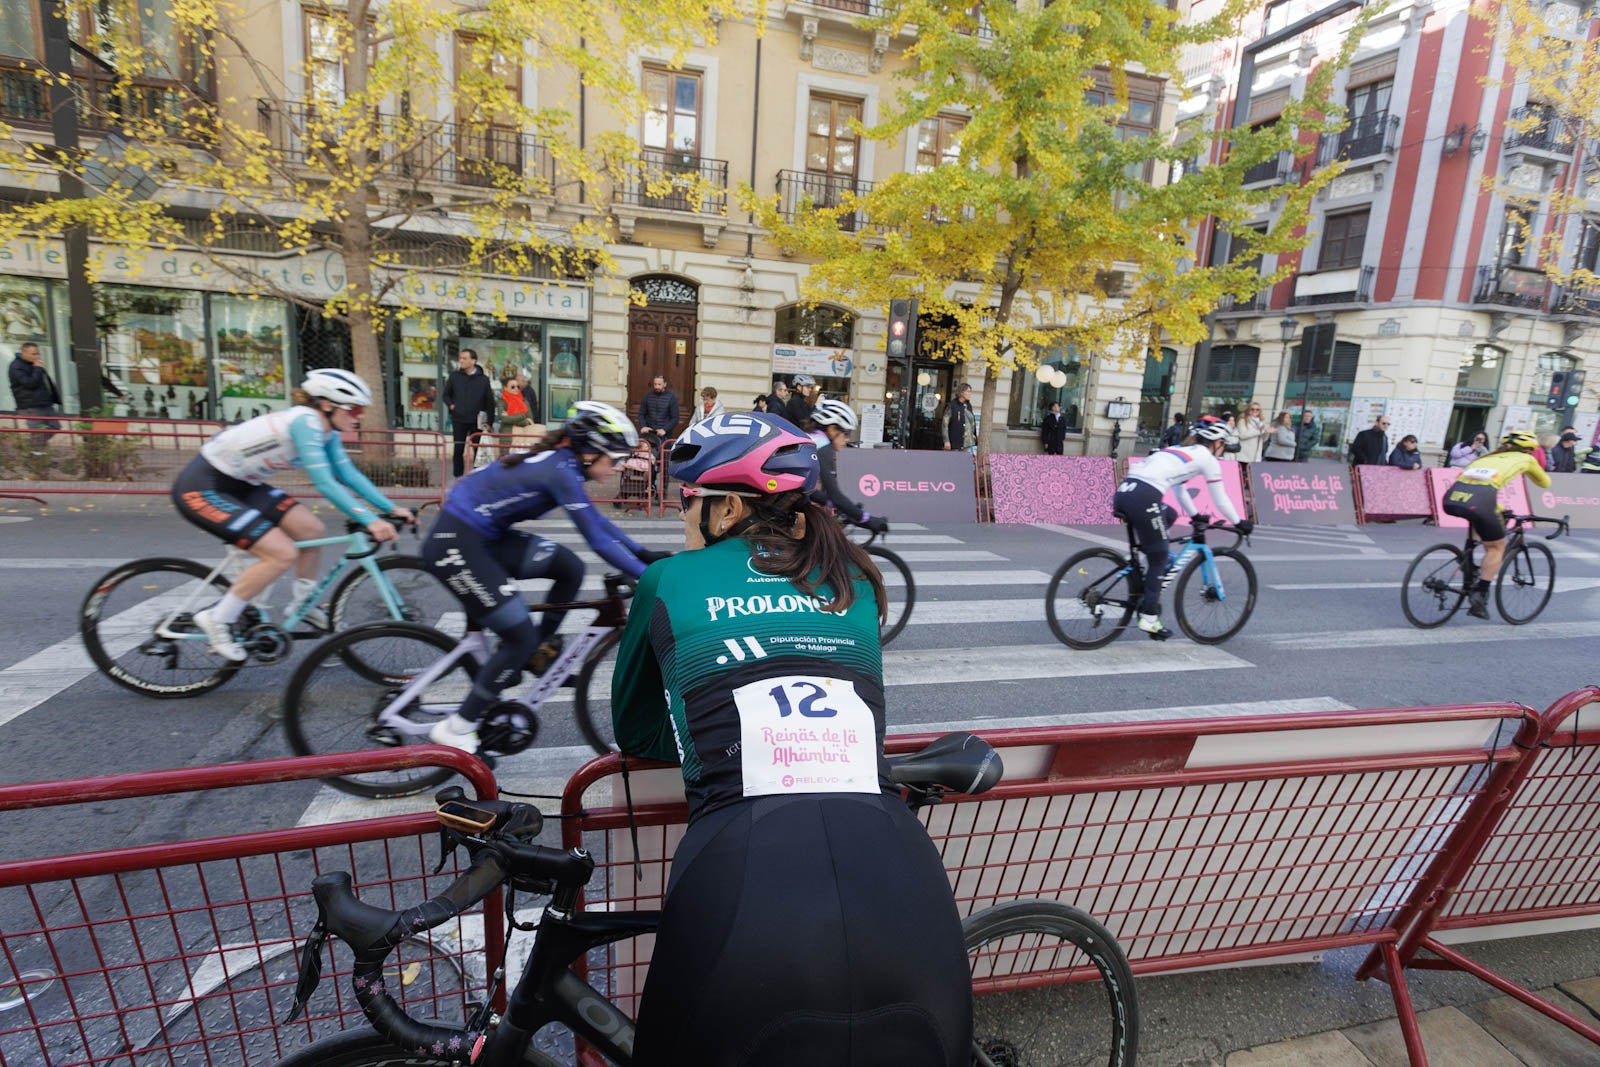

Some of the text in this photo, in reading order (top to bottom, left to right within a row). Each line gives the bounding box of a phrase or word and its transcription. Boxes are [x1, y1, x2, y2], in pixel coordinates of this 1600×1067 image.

[883, 481, 956, 492] RELEVO
[1312, 474, 1328, 494] de
[770, 635, 856, 646] Diputación Provincial
[808, 643, 837, 652] Málaga
[769, 682, 838, 718] 12
[822, 728, 841, 748] de
